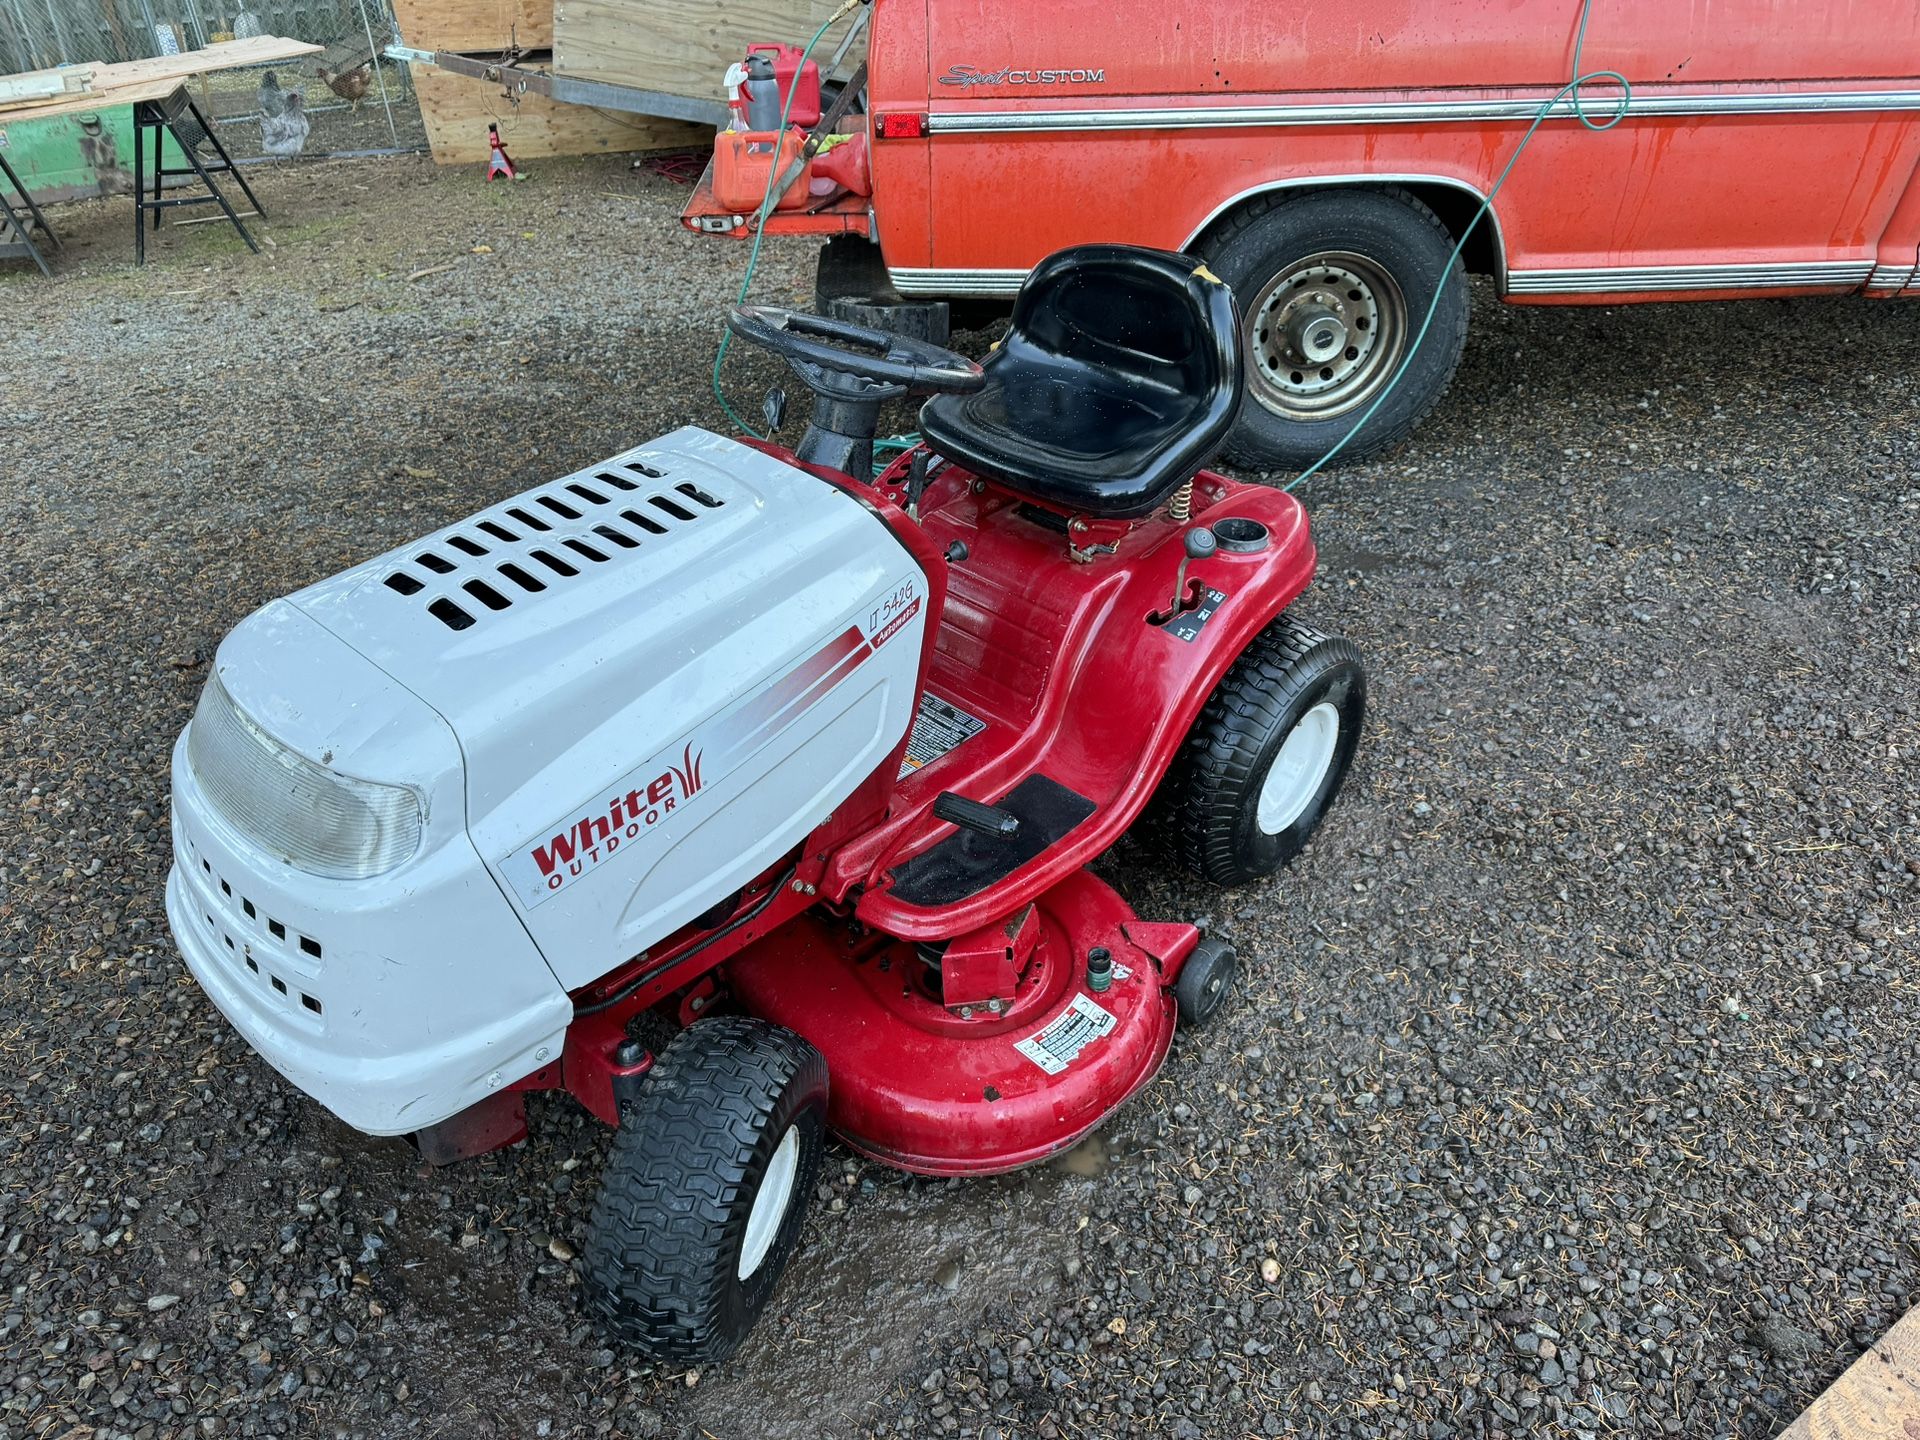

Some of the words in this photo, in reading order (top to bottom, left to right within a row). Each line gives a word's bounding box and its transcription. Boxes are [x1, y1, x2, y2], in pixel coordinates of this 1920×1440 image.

[938, 64, 1010, 89] Sport
[1008, 69, 1105, 84] CUSTOM
[876, 604, 916, 645] Automatic
[530, 771, 673, 877] White
[547, 796, 676, 890] OUTDOOR
